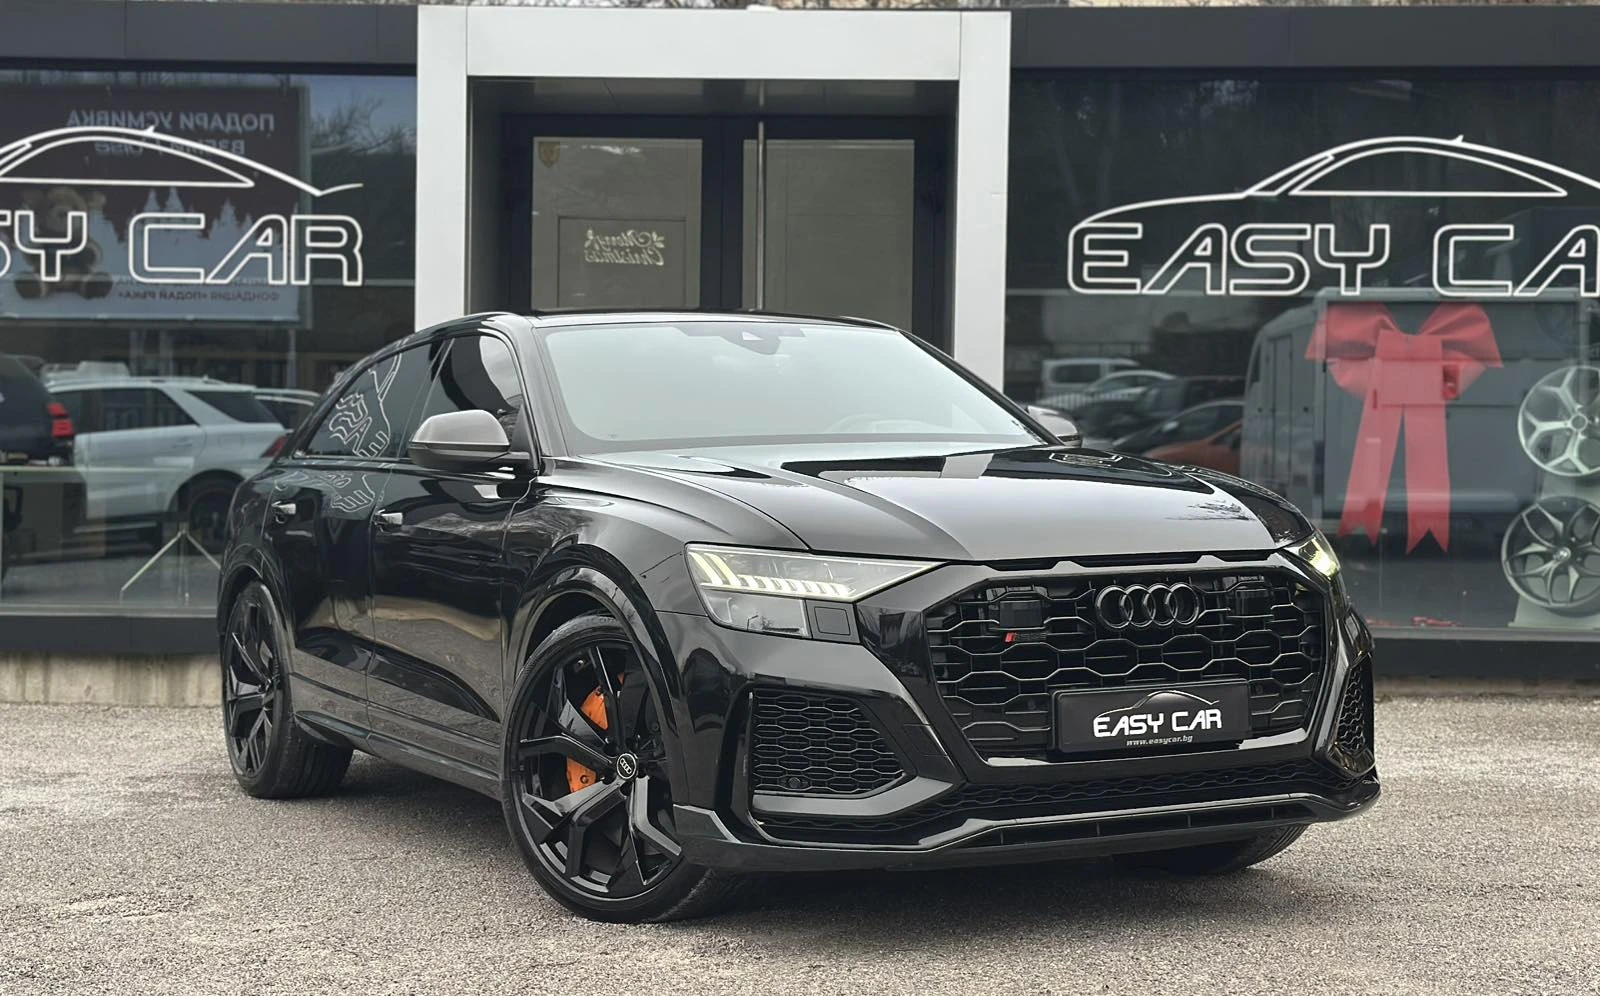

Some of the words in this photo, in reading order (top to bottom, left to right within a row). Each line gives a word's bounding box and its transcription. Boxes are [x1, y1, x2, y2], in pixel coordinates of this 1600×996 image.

[128, 212, 363, 286] CAR
[1067, 222, 1390, 296] EASY
[1093, 713, 1164, 737] EASY
[1171, 708, 1222, 732] CAR
[1126, 735, 1193, 746] www.easycar.bg
